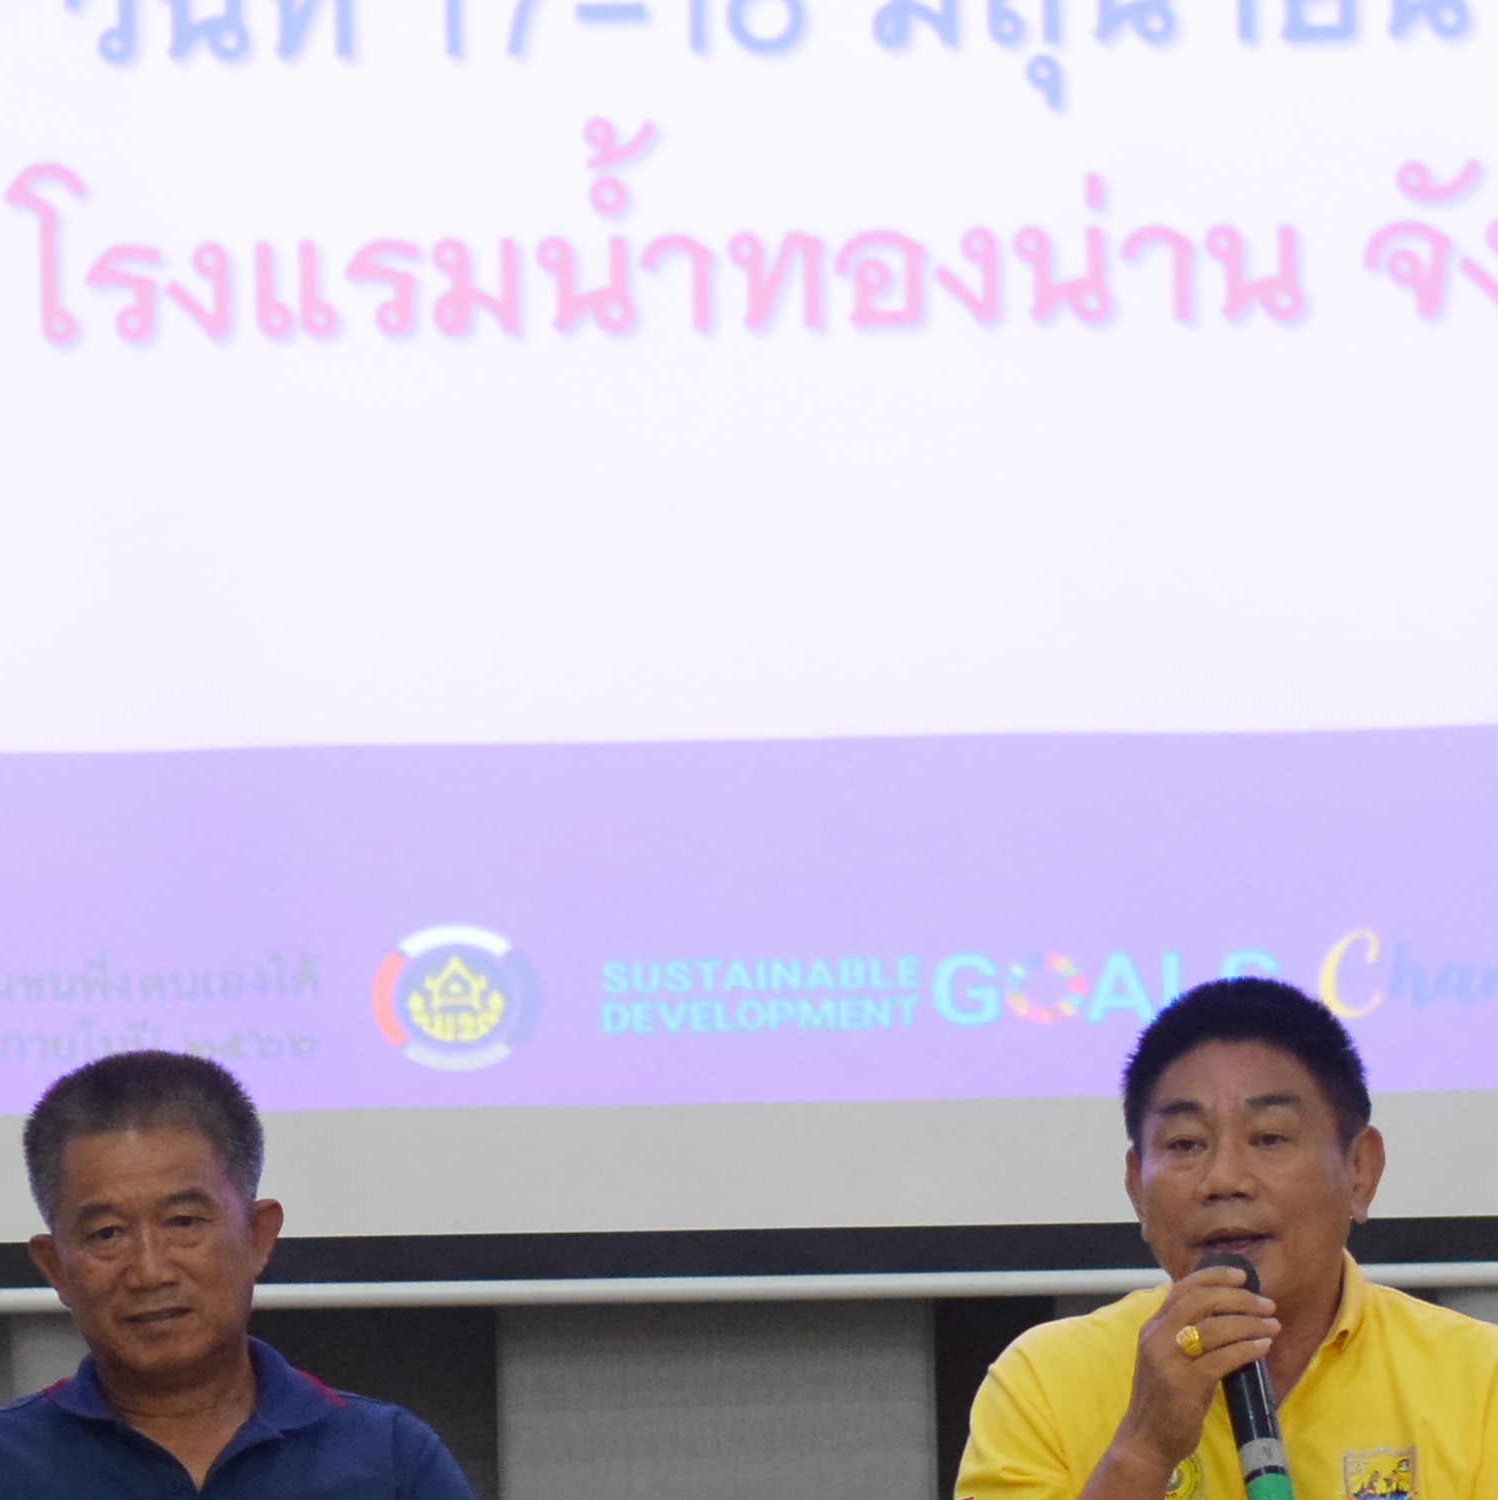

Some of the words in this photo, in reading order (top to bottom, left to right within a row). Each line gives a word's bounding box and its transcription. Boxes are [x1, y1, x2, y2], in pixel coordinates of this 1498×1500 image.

[4, 117, 1307, 346] โรงแรมน้ำทองน่าน
[601, 956, 922, 996] SUSTAINABLE
[601, 997, 917, 1034] DEVELOPMENT
